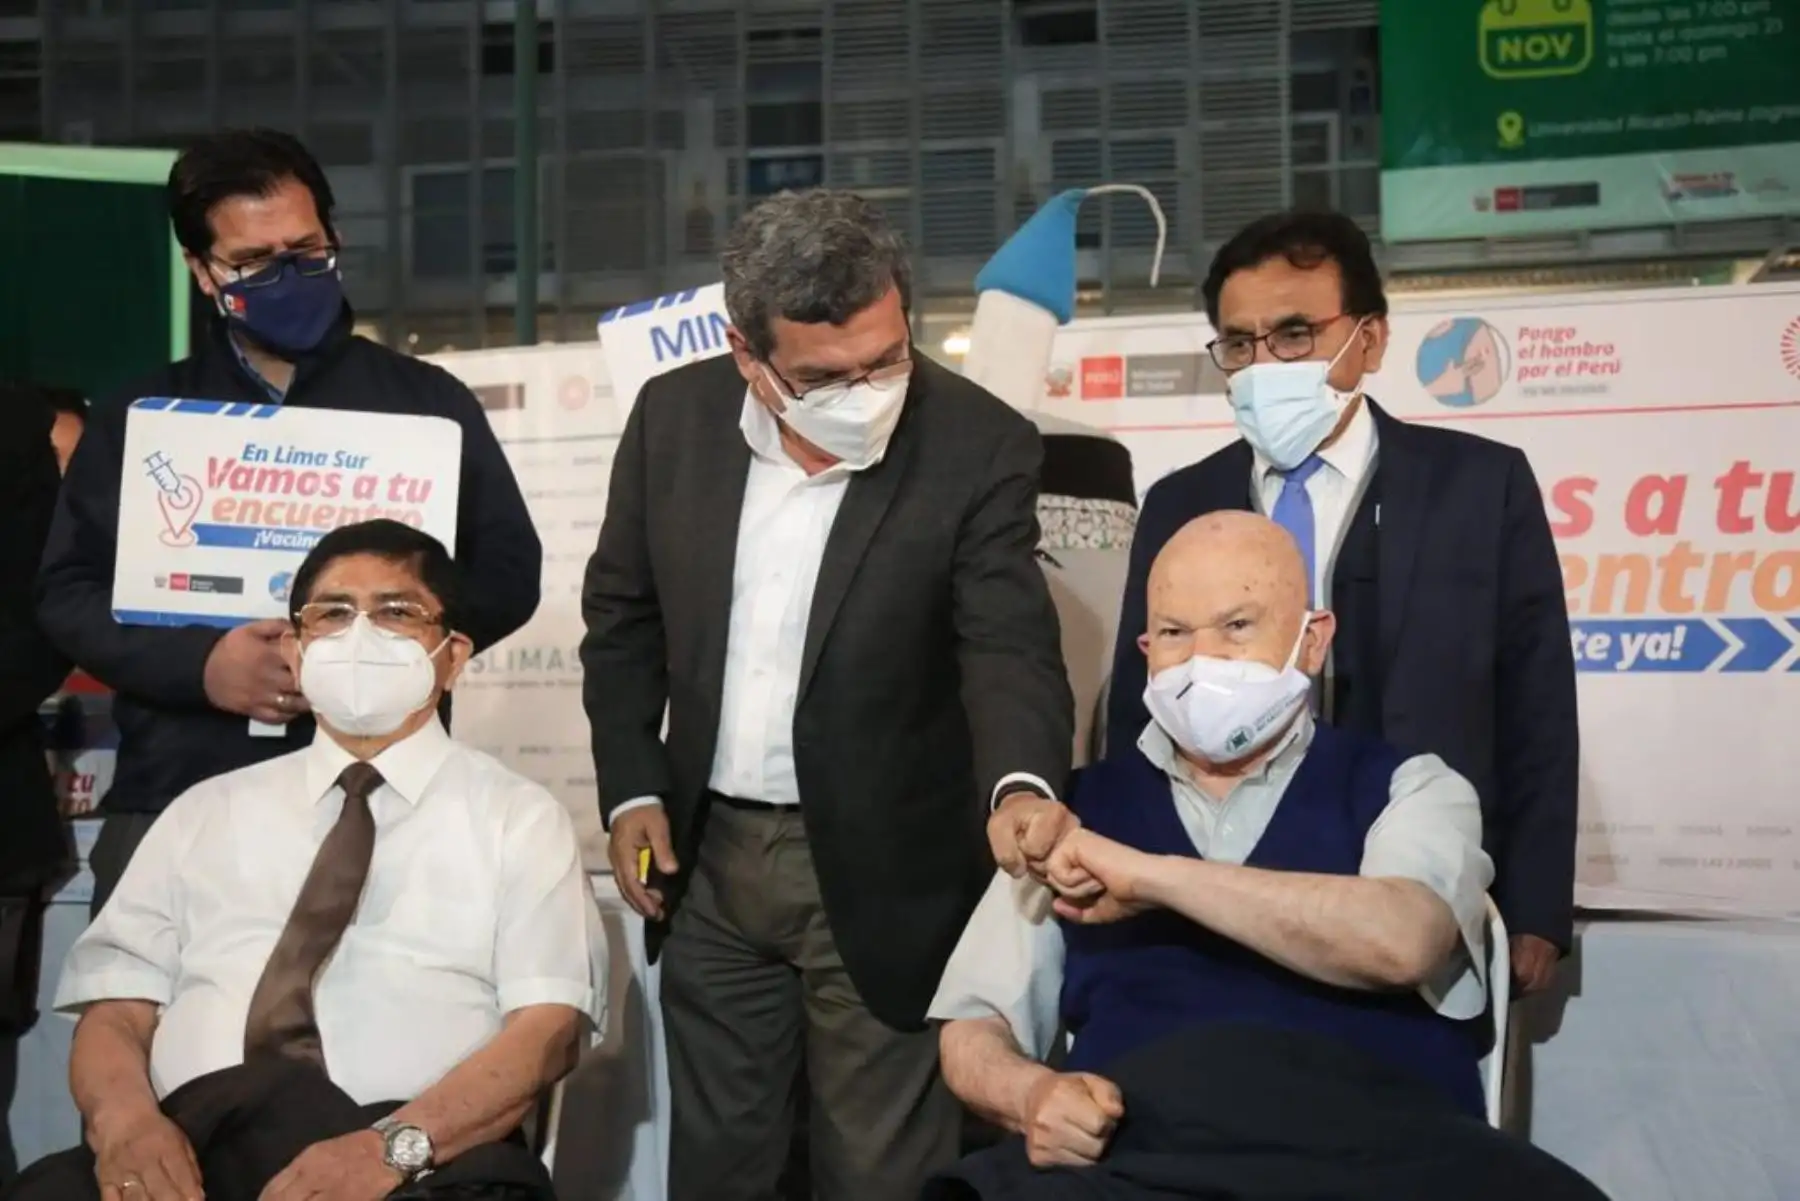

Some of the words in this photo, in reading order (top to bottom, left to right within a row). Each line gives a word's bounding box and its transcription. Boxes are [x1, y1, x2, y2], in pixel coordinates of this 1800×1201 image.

[1498, 33, 1574, 62] NOV
[1518, 326, 1576, 343] Pongo
[1518, 344, 1535, 359] el
[1541, 341, 1614, 358] hombro
[1517, 365, 1548, 383] por
[1555, 361, 1572, 377] el
[1577, 358, 1621, 375] Perú
[242, 443, 268, 462] En
[274, 446, 326, 466] Lima
[333, 450, 369, 470] Sur
[208, 457, 342, 498] Vamos
[353, 474, 378, 500] a
[387, 473, 432, 504] tu
[1624, 473, 1688, 537] a
[1714, 460, 1800, 534] tu
[1615, 625, 1687, 671] ya!
